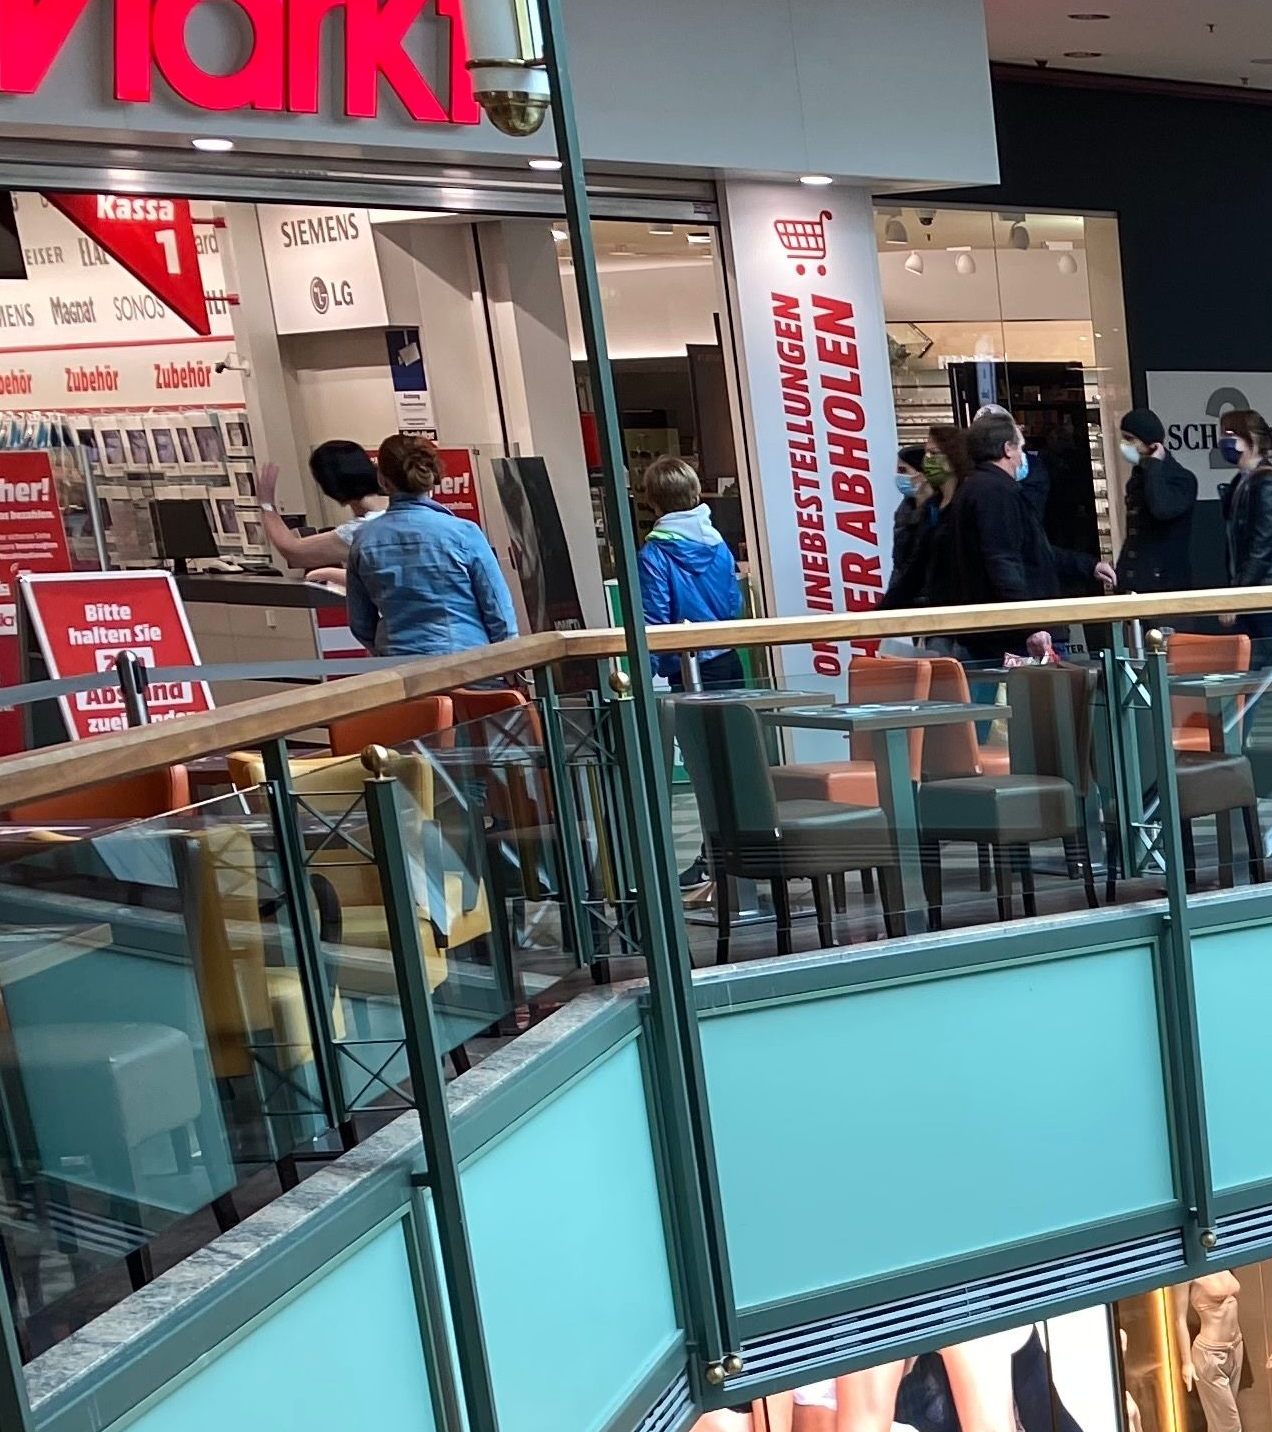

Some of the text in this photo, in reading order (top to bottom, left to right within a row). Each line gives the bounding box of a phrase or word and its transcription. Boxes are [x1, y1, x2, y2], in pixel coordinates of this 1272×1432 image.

[97, 194, 175, 221] Kassa
[25, 246, 64, 266] EISER
[195, 227, 219, 255] ard
[281, 212, 359, 248] SIEMENS
[155, 228, 181, 275] 1
[49, 296, 97, 326] Magnat
[112, 293, 165, 322] SONOS
[331, 280, 354, 306] LG
[0, 360, 212, 395] behör Zubehör Zubehör
[811, 293, 879, 546] ABHOLEN
[0, 477, 50, 501] her!
[771, 291, 841, 677] OINEBESTELLUNGEN
[84, 604, 132, 622] Bitte
[68, 624, 162, 646] halten Sie
